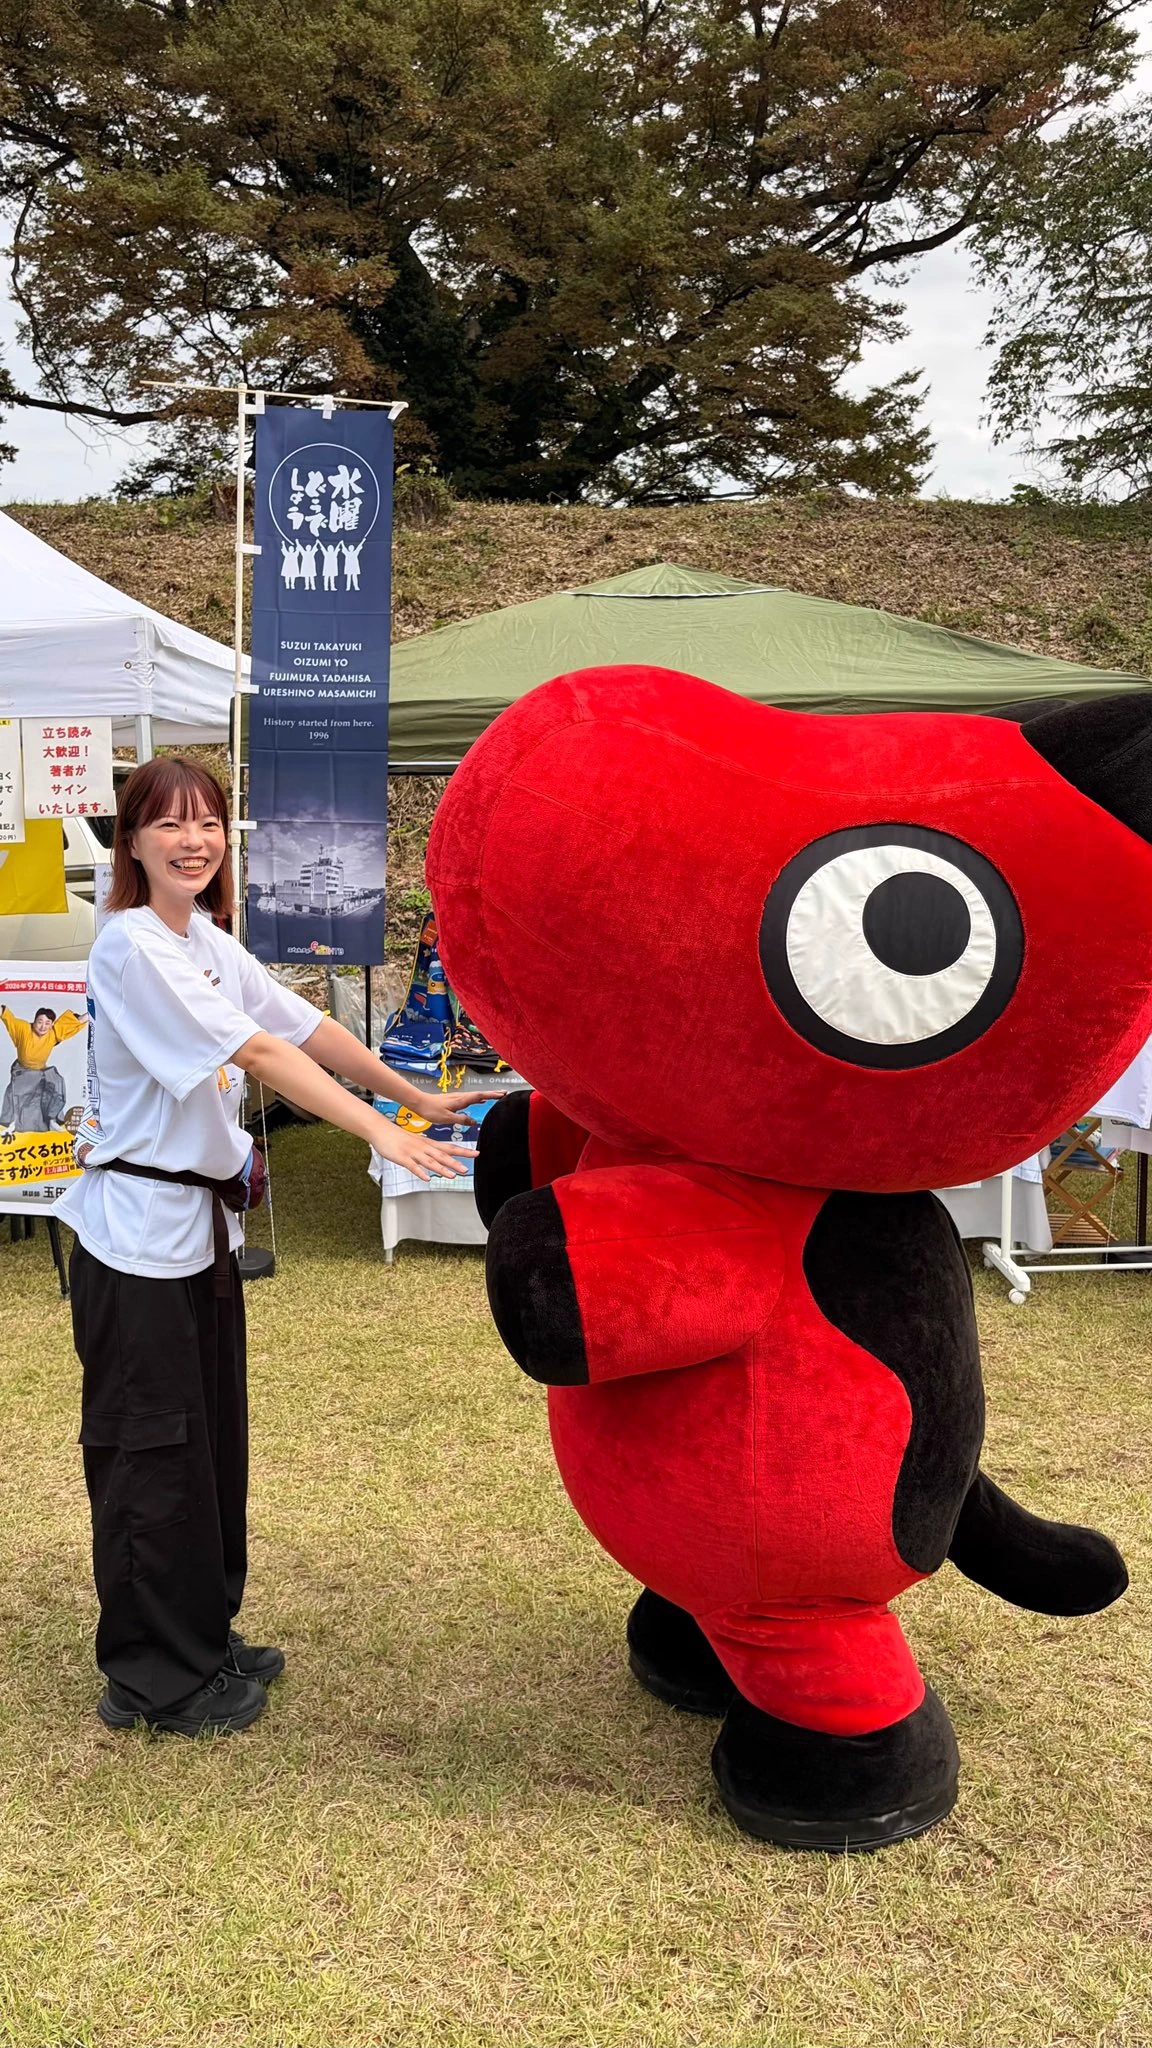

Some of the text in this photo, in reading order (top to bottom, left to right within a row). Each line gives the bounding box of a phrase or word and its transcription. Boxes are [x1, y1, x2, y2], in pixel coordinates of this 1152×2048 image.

[286, 467, 305, 530] しょう
[305, 470, 329, 537] どうで
[328, 464, 365, 533] 水曜
[280, 641, 362, 651] SUZUI TAKAYUKI
[293, 657, 349, 667] OIZUMI YO
[269, 672, 371, 683] FUJIMURA TADAHISA
[263, 688, 376, 698] URESHINO MASAMICHI
[263, 717, 375, 729] History started from here.
[42, 726, 93, 739] 立ち読み
[309, 731, 329, 740] 1996
[42, 745, 89, 758] 大歓迎！
[50, 764, 87, 777] 著者が
[51, 784, 88, 795] サイン
[38, 802, 109, 815] いたします。
